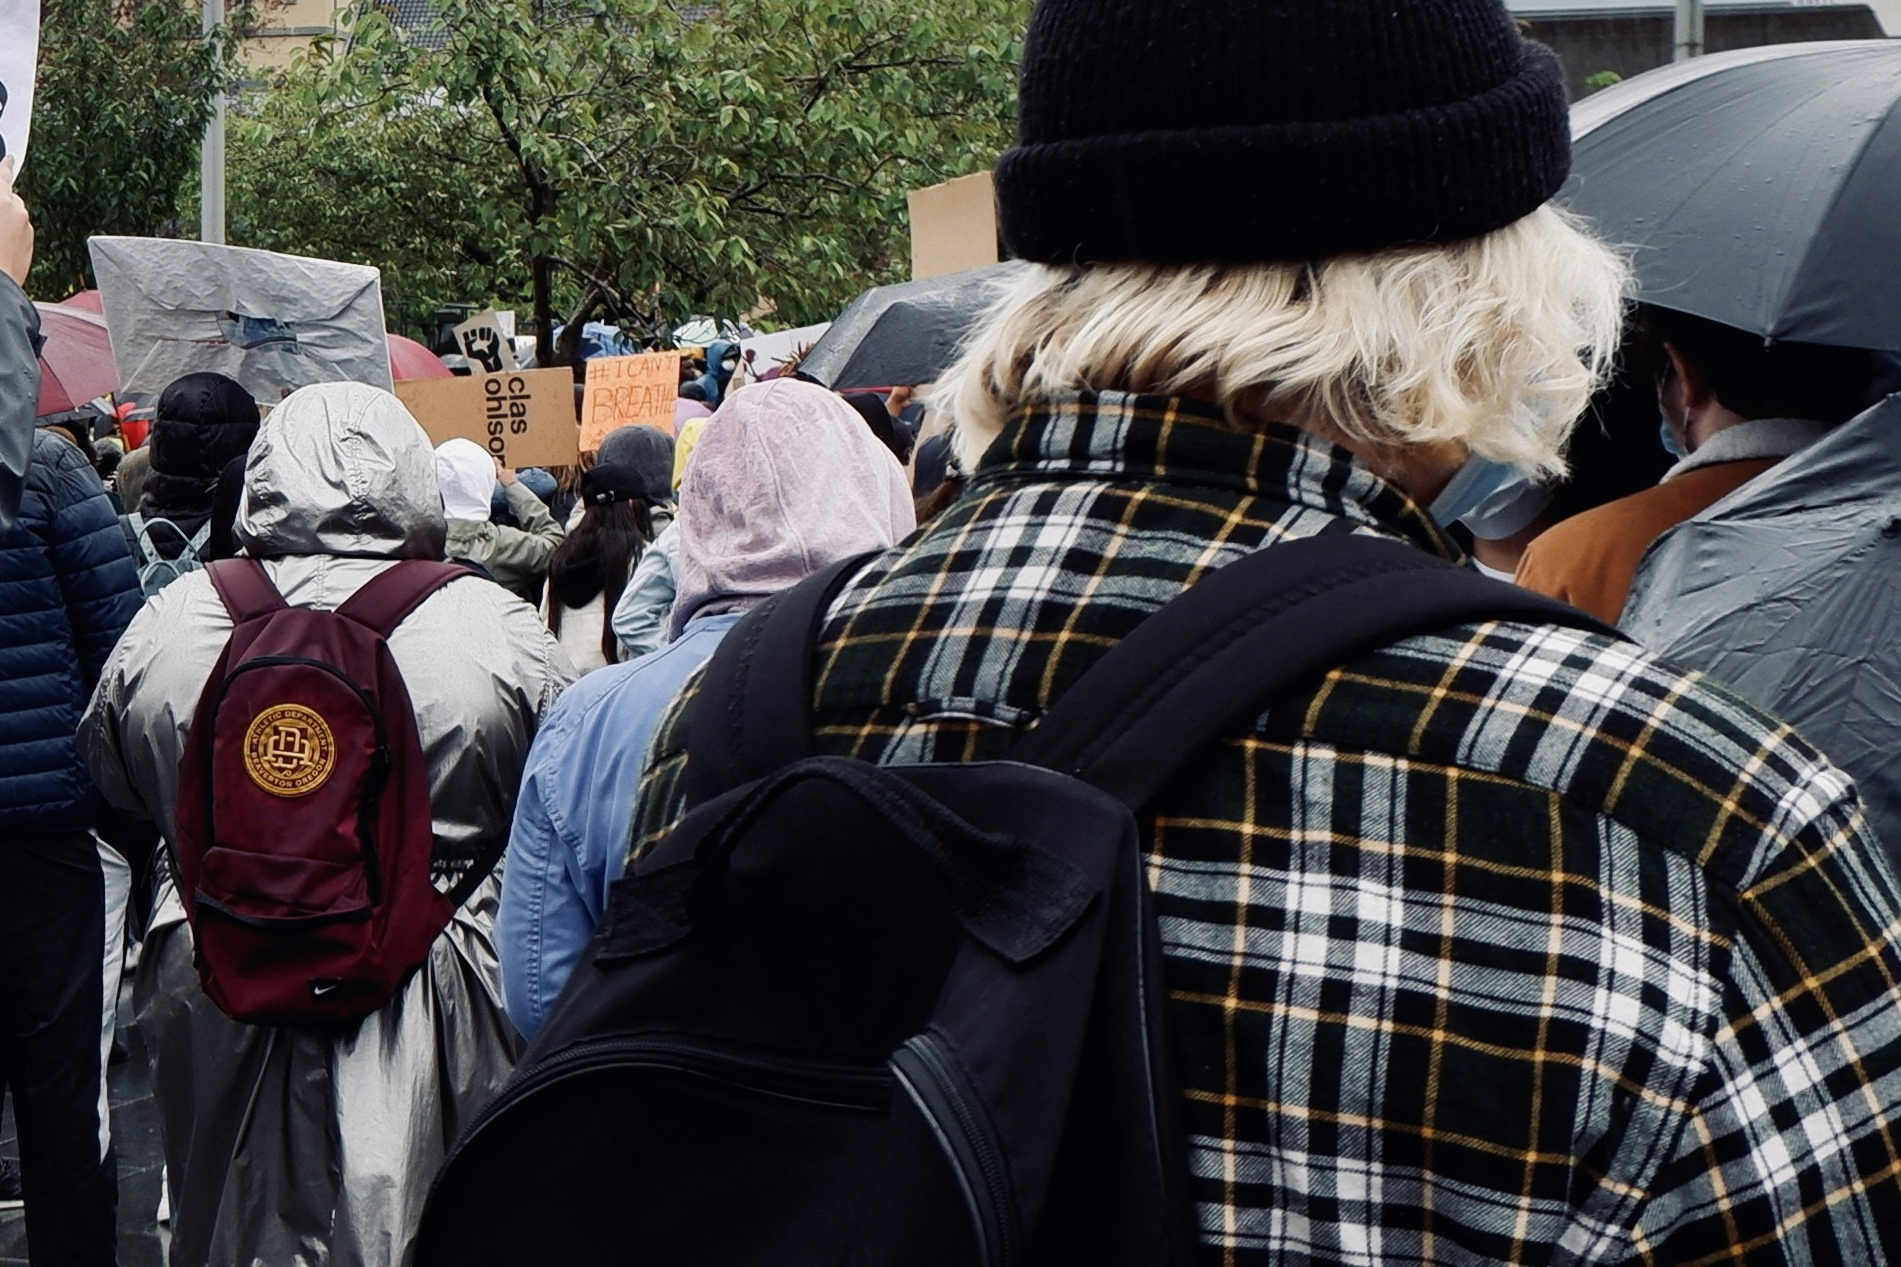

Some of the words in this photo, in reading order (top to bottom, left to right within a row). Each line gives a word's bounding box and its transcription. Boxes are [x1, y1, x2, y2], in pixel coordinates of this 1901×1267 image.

[508, 376, 531, 435] clas
[591, 382, 677, 424] BREATHE
[295, 757, 327, 787] OREGON
